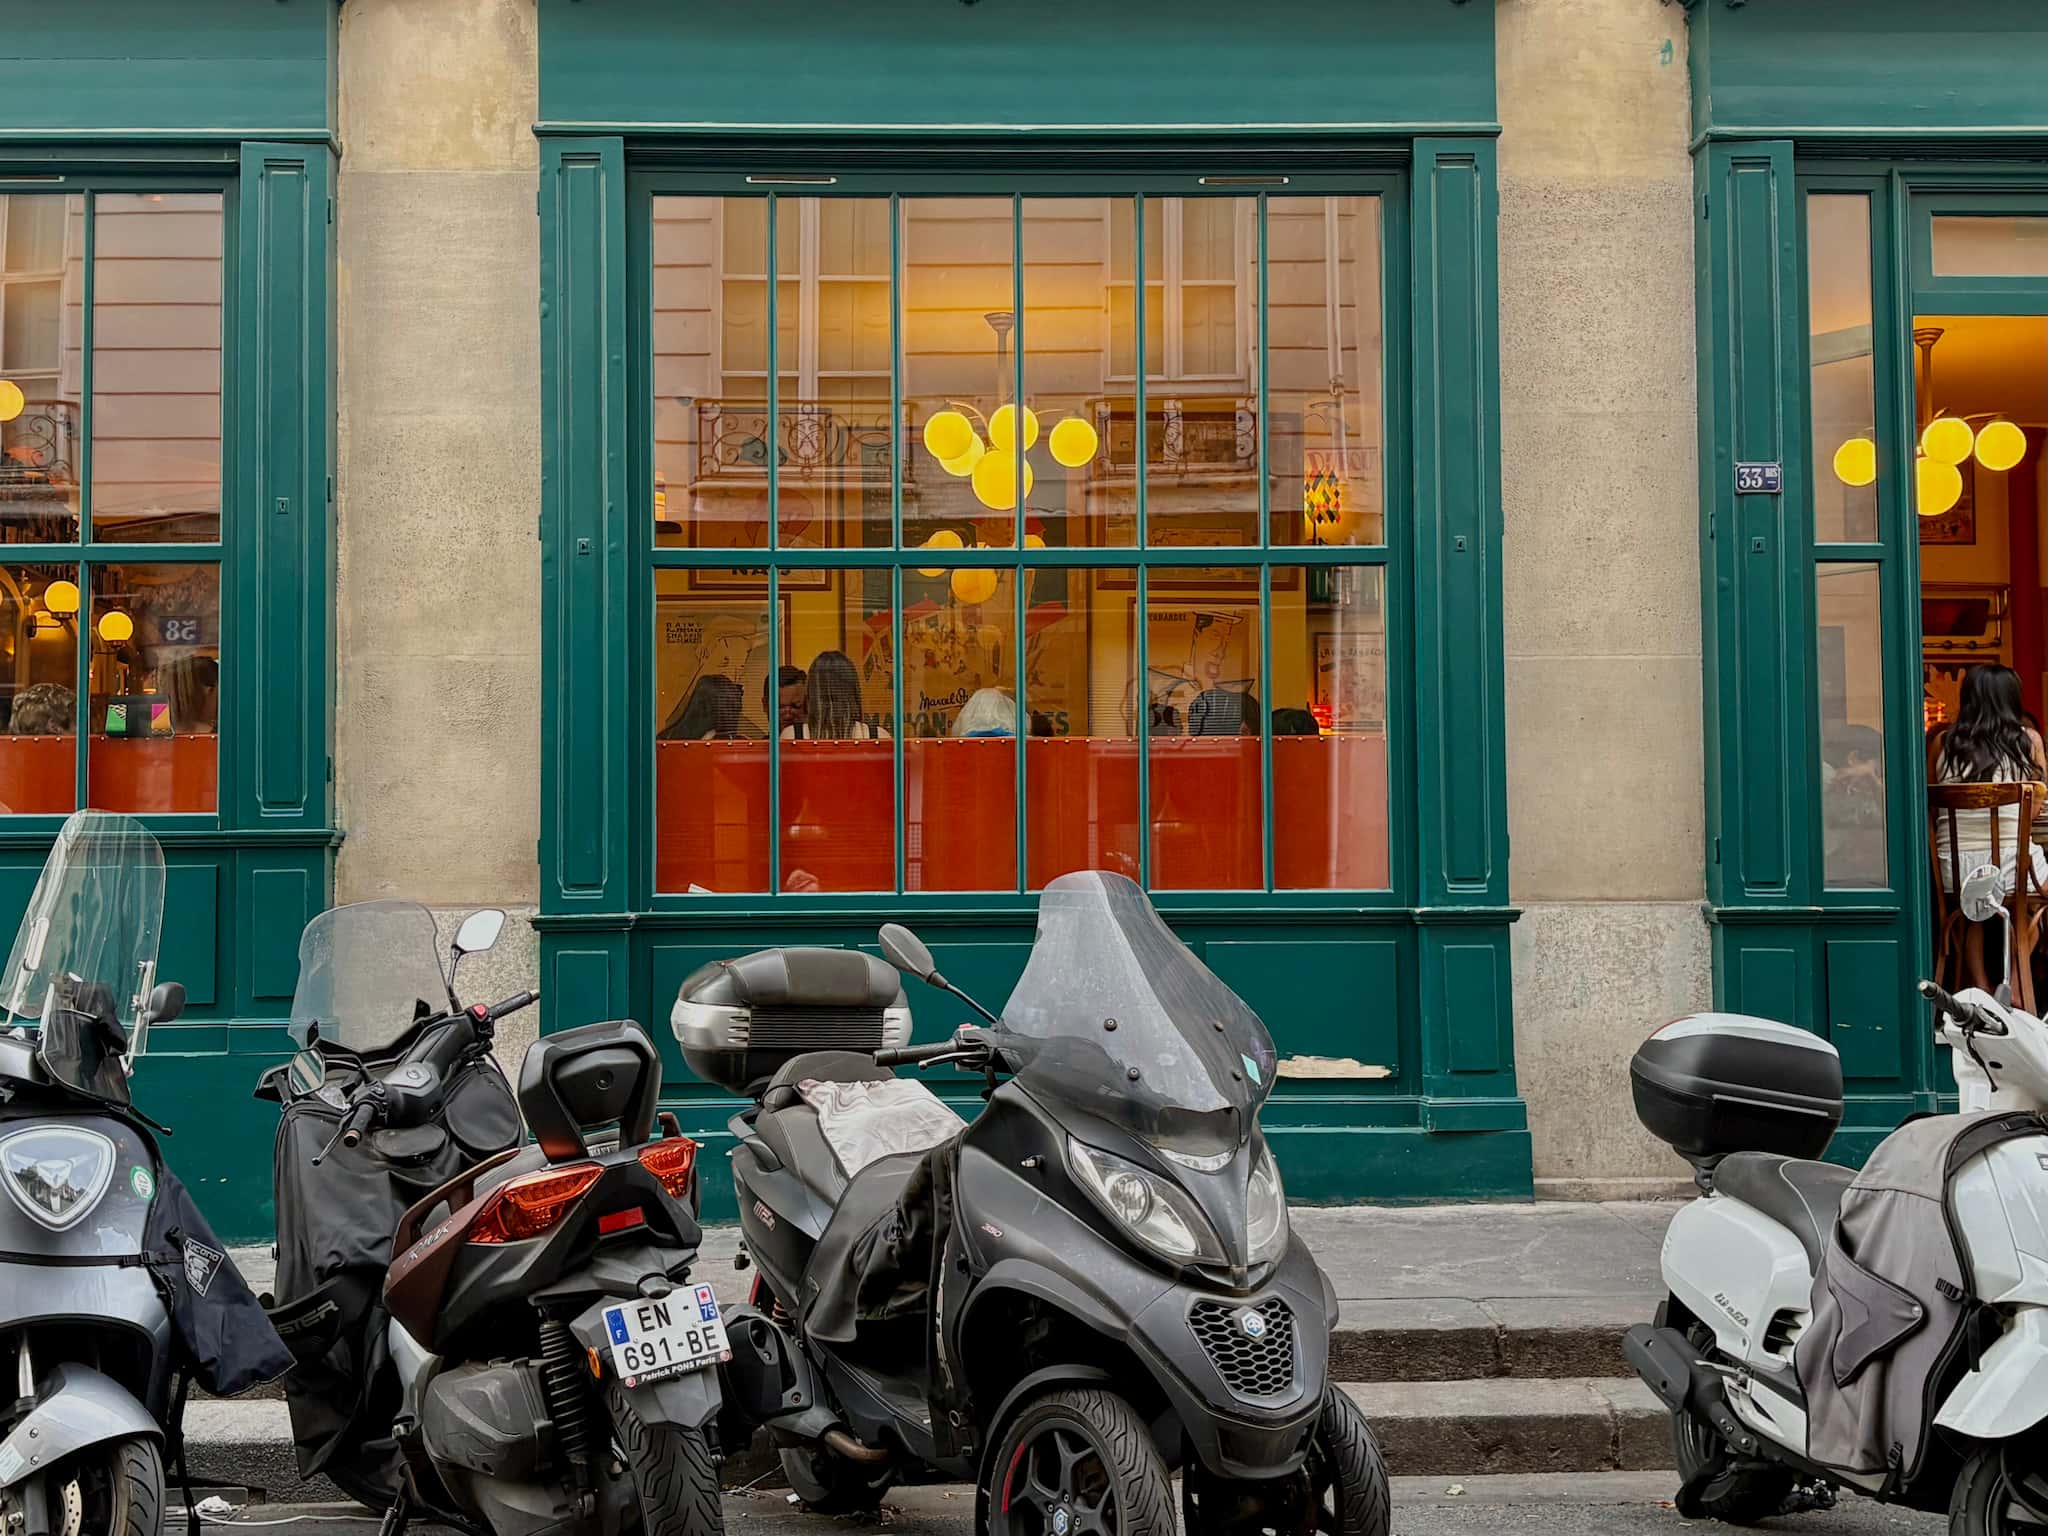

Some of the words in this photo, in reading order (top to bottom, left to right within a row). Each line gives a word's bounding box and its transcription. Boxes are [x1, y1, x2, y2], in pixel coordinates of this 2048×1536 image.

[1739, 467, 1763, 489] 33
[277, 1298, 340, 1335] STER
[701, 1303, 716, 1319] 75
[615, 1329, 623, 1339] F
[623, 1325, 720, 1371] 691-BE
[640, 1367, 671, 1383] Patrick
[670, 1360, 696, 1375] PONS
[695, 1356, 717, 1368] Paris
